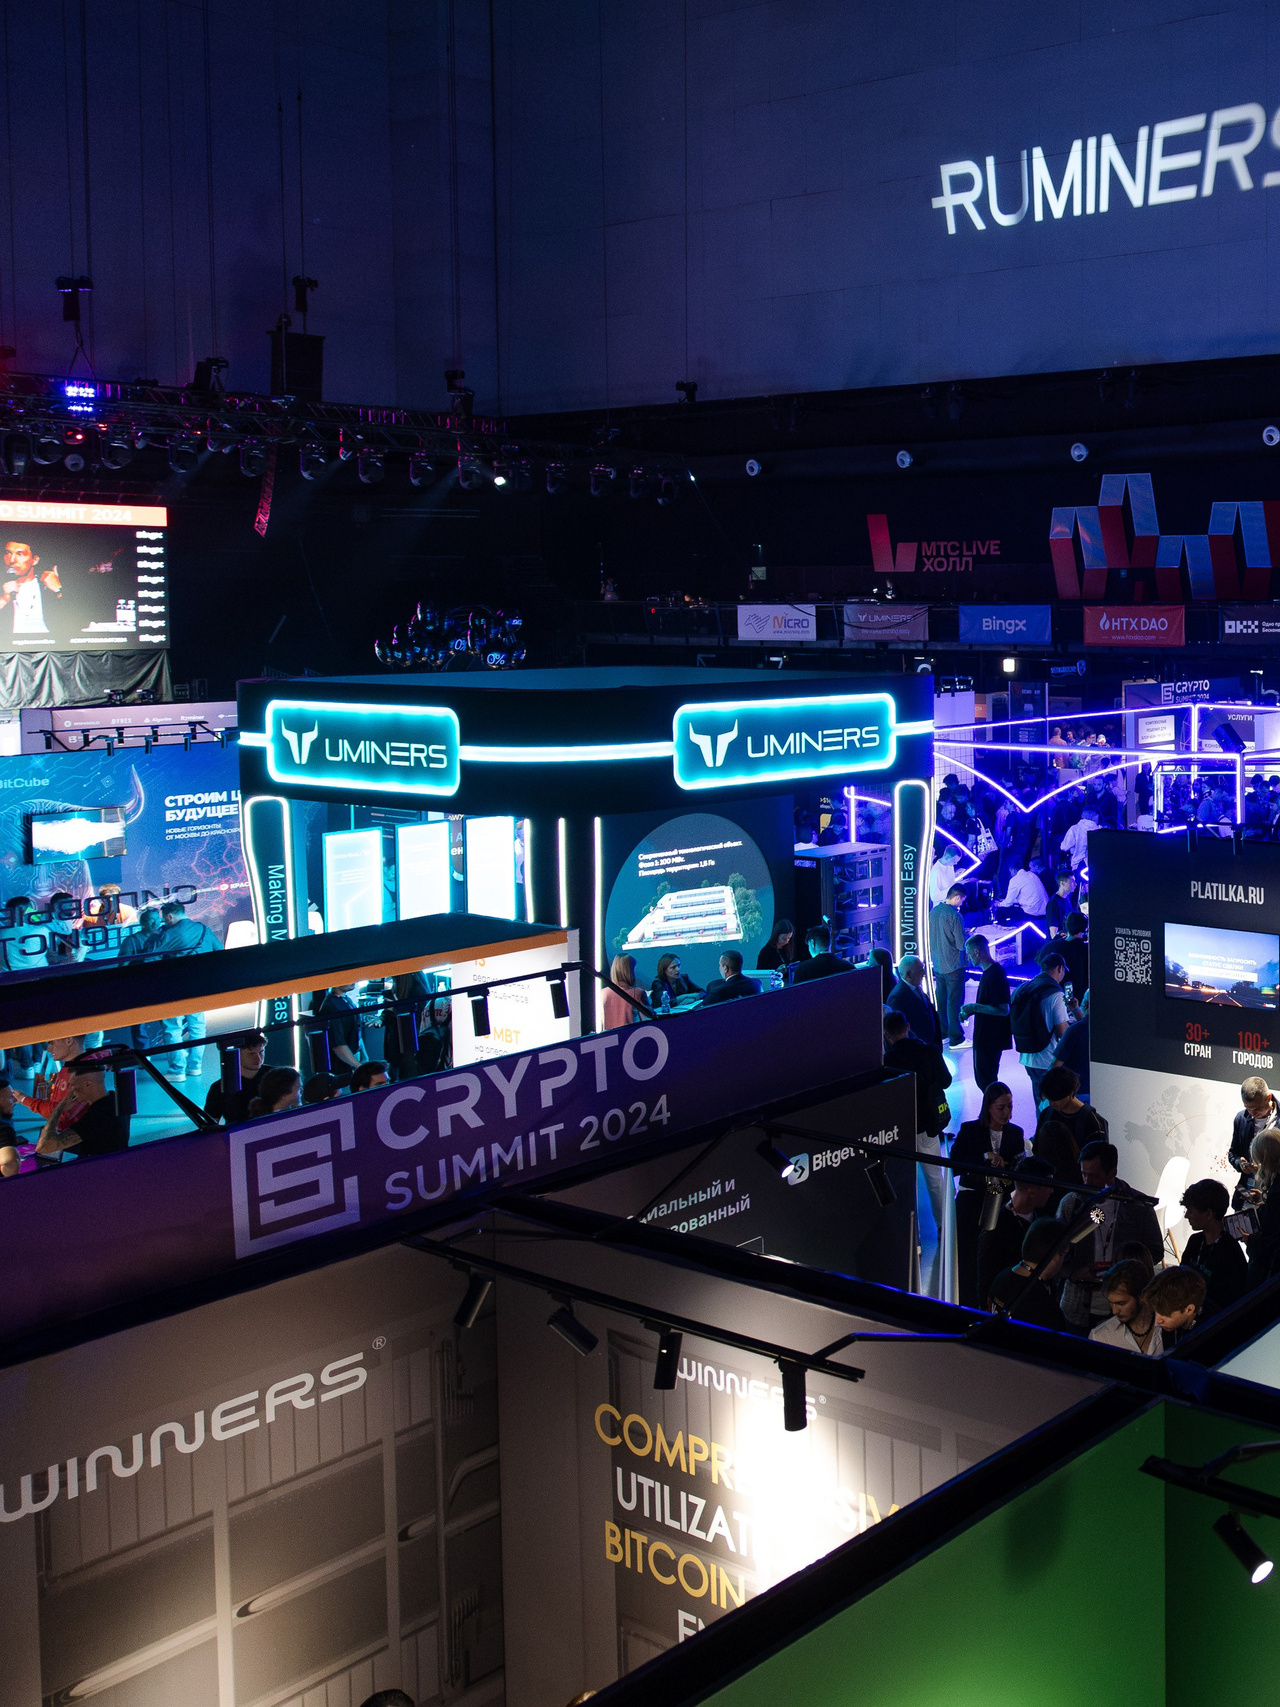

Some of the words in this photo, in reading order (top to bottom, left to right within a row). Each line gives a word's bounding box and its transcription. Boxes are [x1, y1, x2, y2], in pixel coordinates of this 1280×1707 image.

[16, 505, 86, 520] SUMMIT
[91, 508, 132, 522] 2024
[963, 540, 1001, 555] LIVE
[923, 556, 973, 572] ХОЛЛ
[1112, 618, 1139, 631] HTX
[1141, 618, 1169, 631] DAO
[1225, 621, 1259, 633] OKX
[487, 653, 505, 665] 0%
[1175, 680, 1210, 694] CRYPTO
[1227, 713, 1253, 721] УСЛУГИ
[746, 725, 880, 759] UMINERS
[324, 737, 448, 769] UMINERS
[164, 790, 228, 808] СТРОИМ
[165, 804, 239, 822] БУДУЩЕЕ
[901, 843, 918, 882] Easy
[267, 863, 286, 924] Making
[1190, 880, 1265, 905] PLATILKA.RU
[901, 887, 918, 940] Mining
[1115, 927, 1131, 935] УЗНАТЬ
[1131, 928, 1152, 938] УСЛОВИЯ
[1185, 1022, 1210, 1041] 30+
[1237, 1030, 1270, 1051] 100+
[1184, 1043, 1212, 1059] СТРАН
[1232, 1050, 1274, 1069] ГОРОДОВ
[375, 1025, 669, 1150] CRYPTO
[385, 1123, 565, 1212] SUMMIT
[579, 1094, 672, 1152] 2024
[812, 1146, 856, 1172] Bitget
[725, 1177, 736, 1193] и
[0, 1352, 368, 1523] WINNERS
[604, 1519, 746, 1610] BITCOIN
